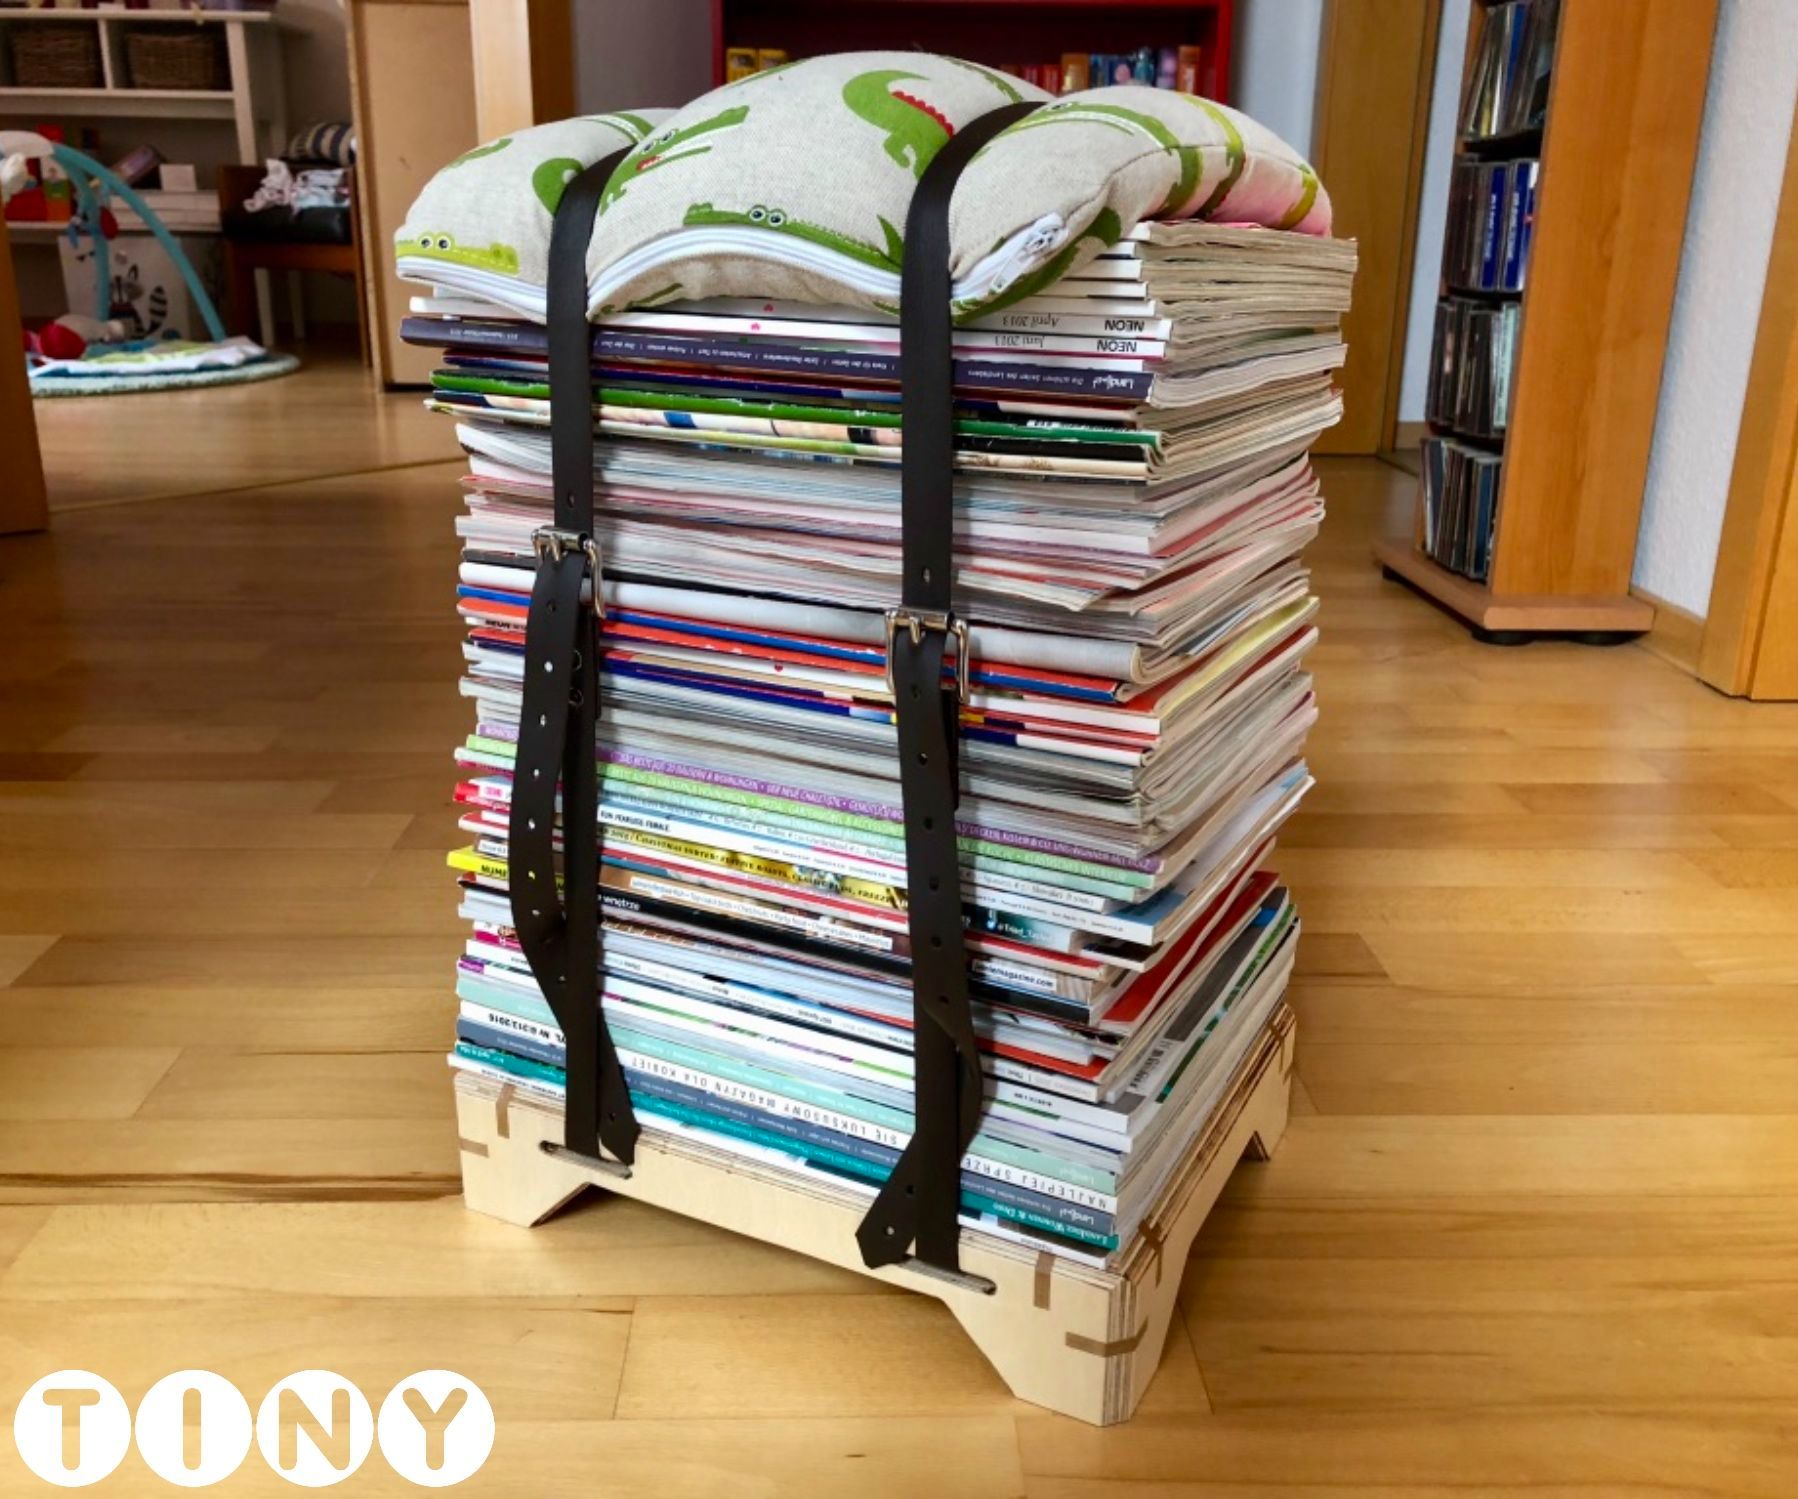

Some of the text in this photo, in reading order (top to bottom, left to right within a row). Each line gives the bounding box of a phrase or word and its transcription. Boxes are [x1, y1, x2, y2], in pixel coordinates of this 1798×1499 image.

[1030, 312, 1060, 328] April
[1104, 316, 1144, 333] NEON
[1096, 337, 1138, 354] NEON
[603, 895, 640, 911] wnętrze
[631, 1056, 675, 1078] KOBIET
[685, 1071, 707, 1087] DLA
[714, 1081, 776, 1111] MAGAZYN
[784, 1103, 867, 1137] LUKSUSOWY
[877, 1126, 899, 1146] SIĘ
[964, 1160, 1107, 1210] NAJLEPIEJ SPRZE
